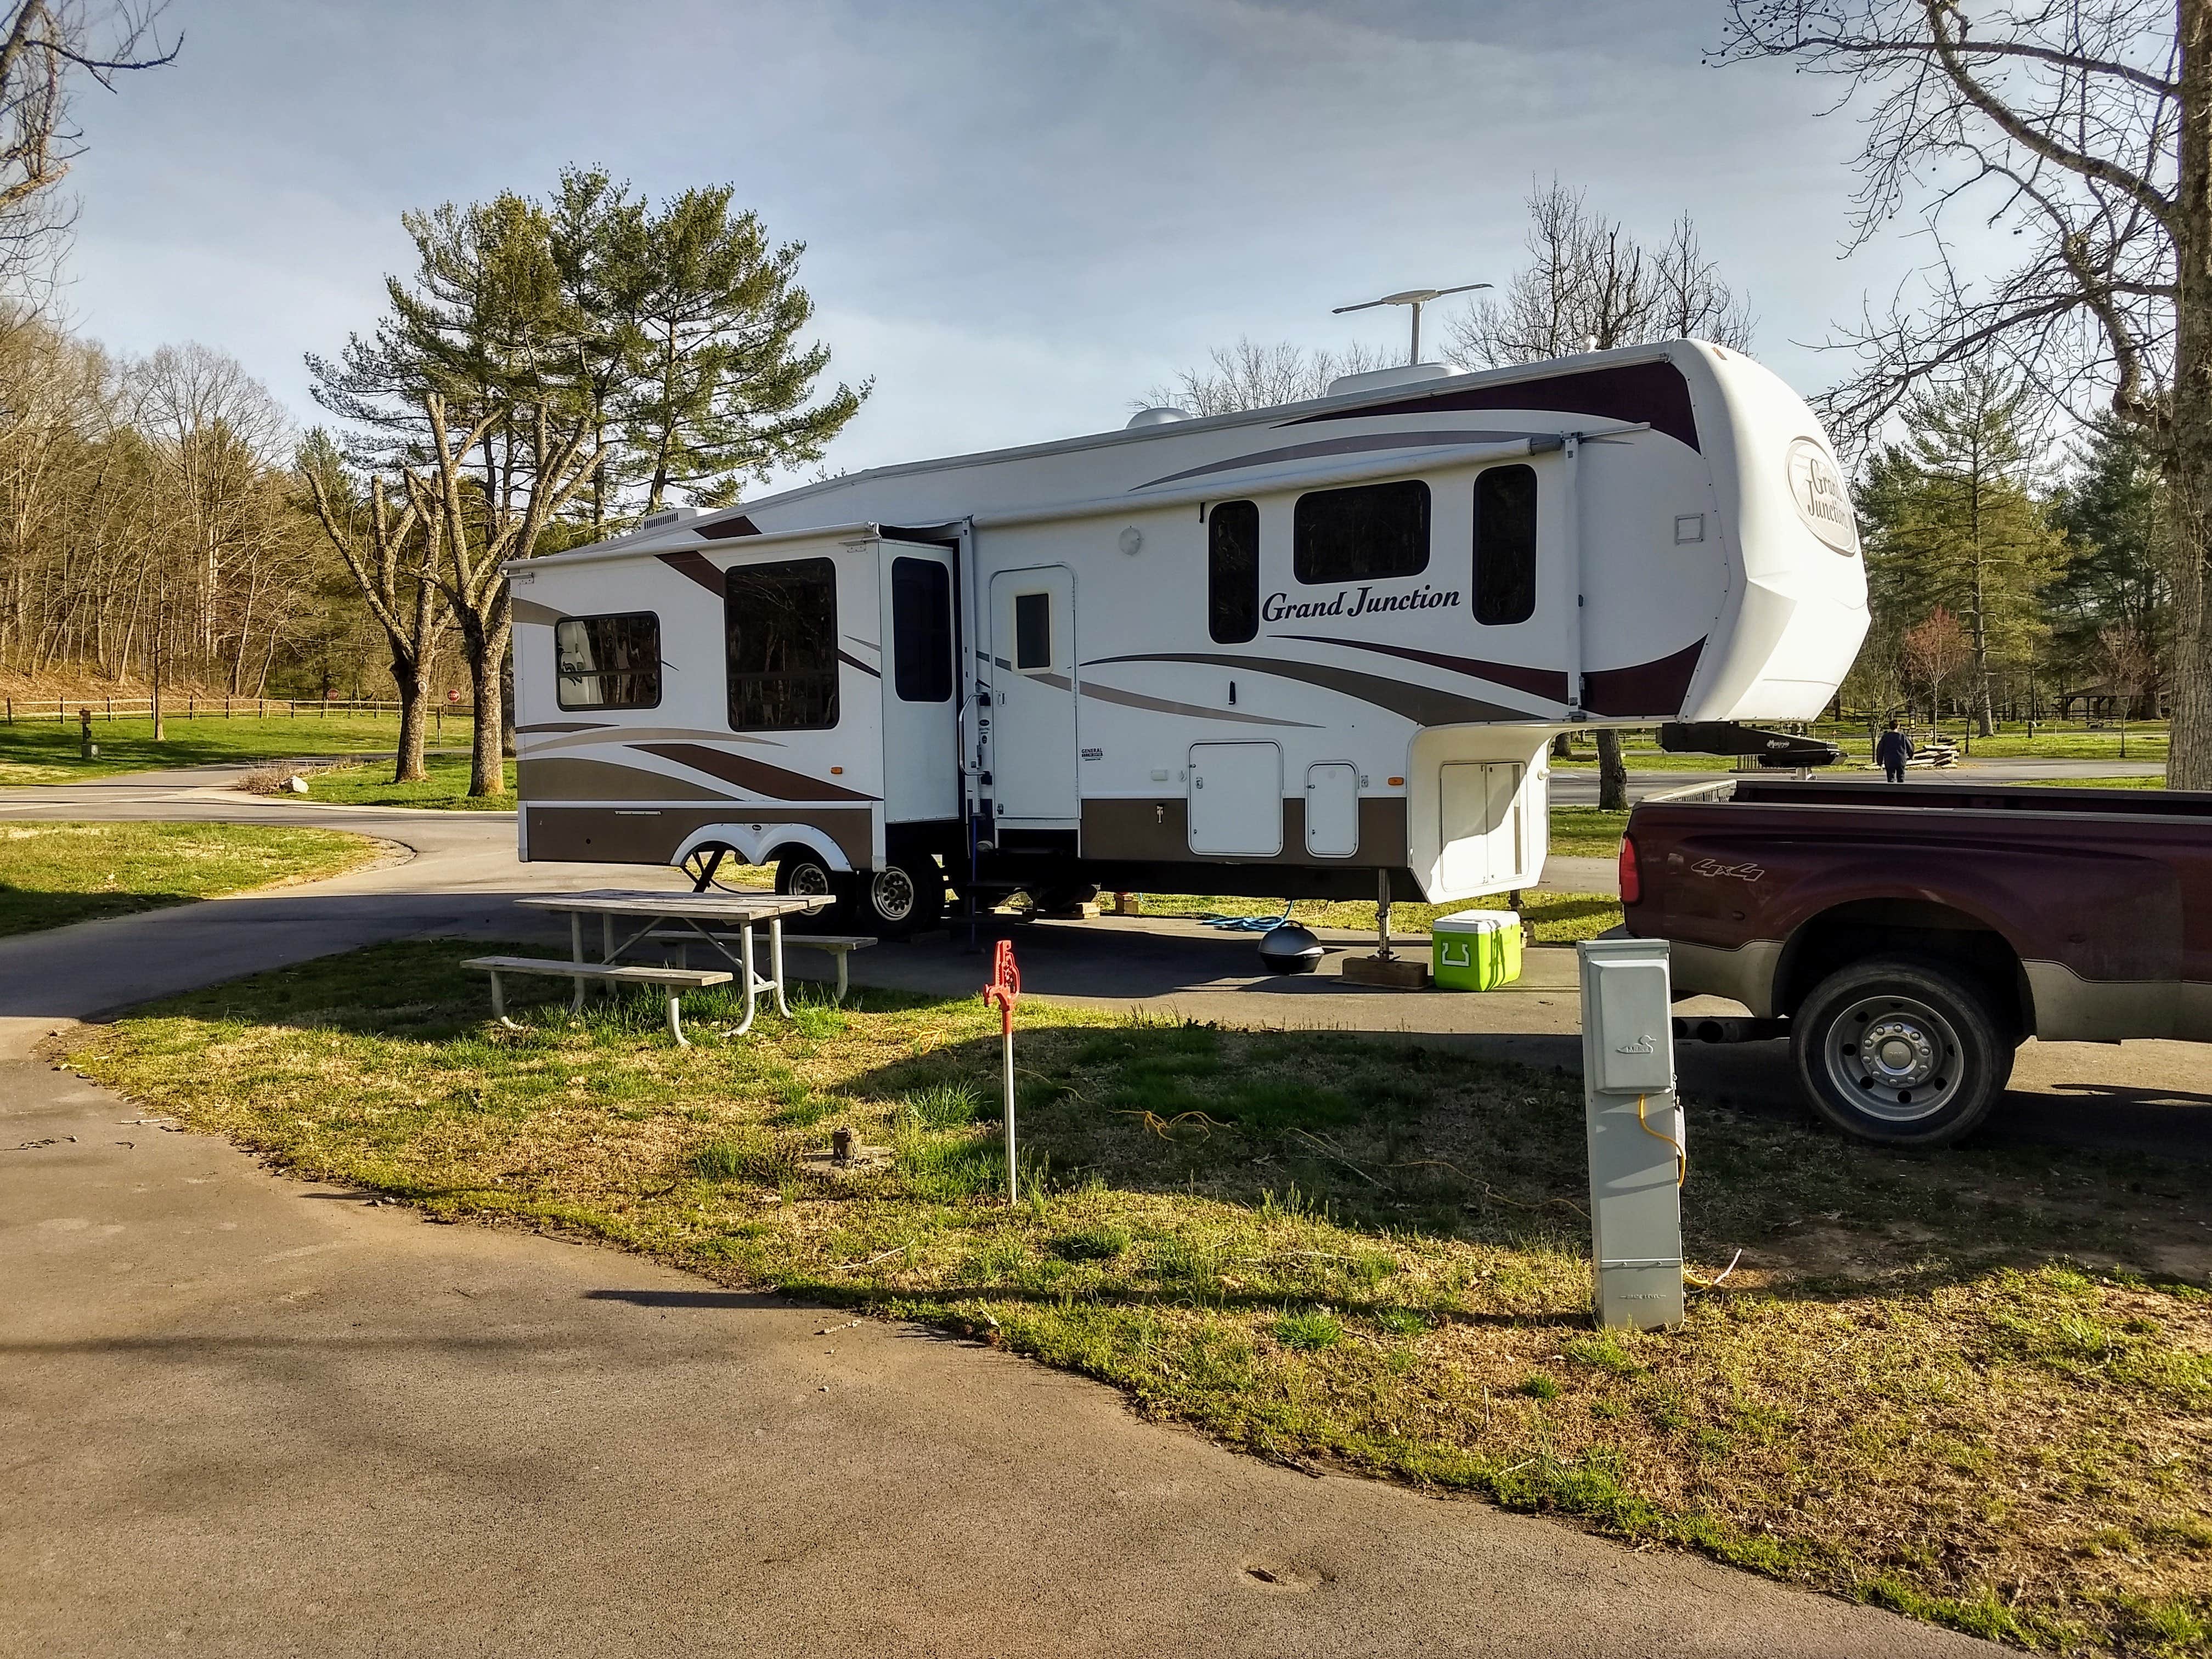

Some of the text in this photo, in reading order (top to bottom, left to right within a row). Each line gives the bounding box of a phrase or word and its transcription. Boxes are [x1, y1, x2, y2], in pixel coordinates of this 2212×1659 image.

[1810, 458, 1843, 503] Grand
[1805, 479, 1848, 530] Junction
[1262, 584, 1460, 622] Grand Junction
[1691, 859, 1765, 882] 4x4
